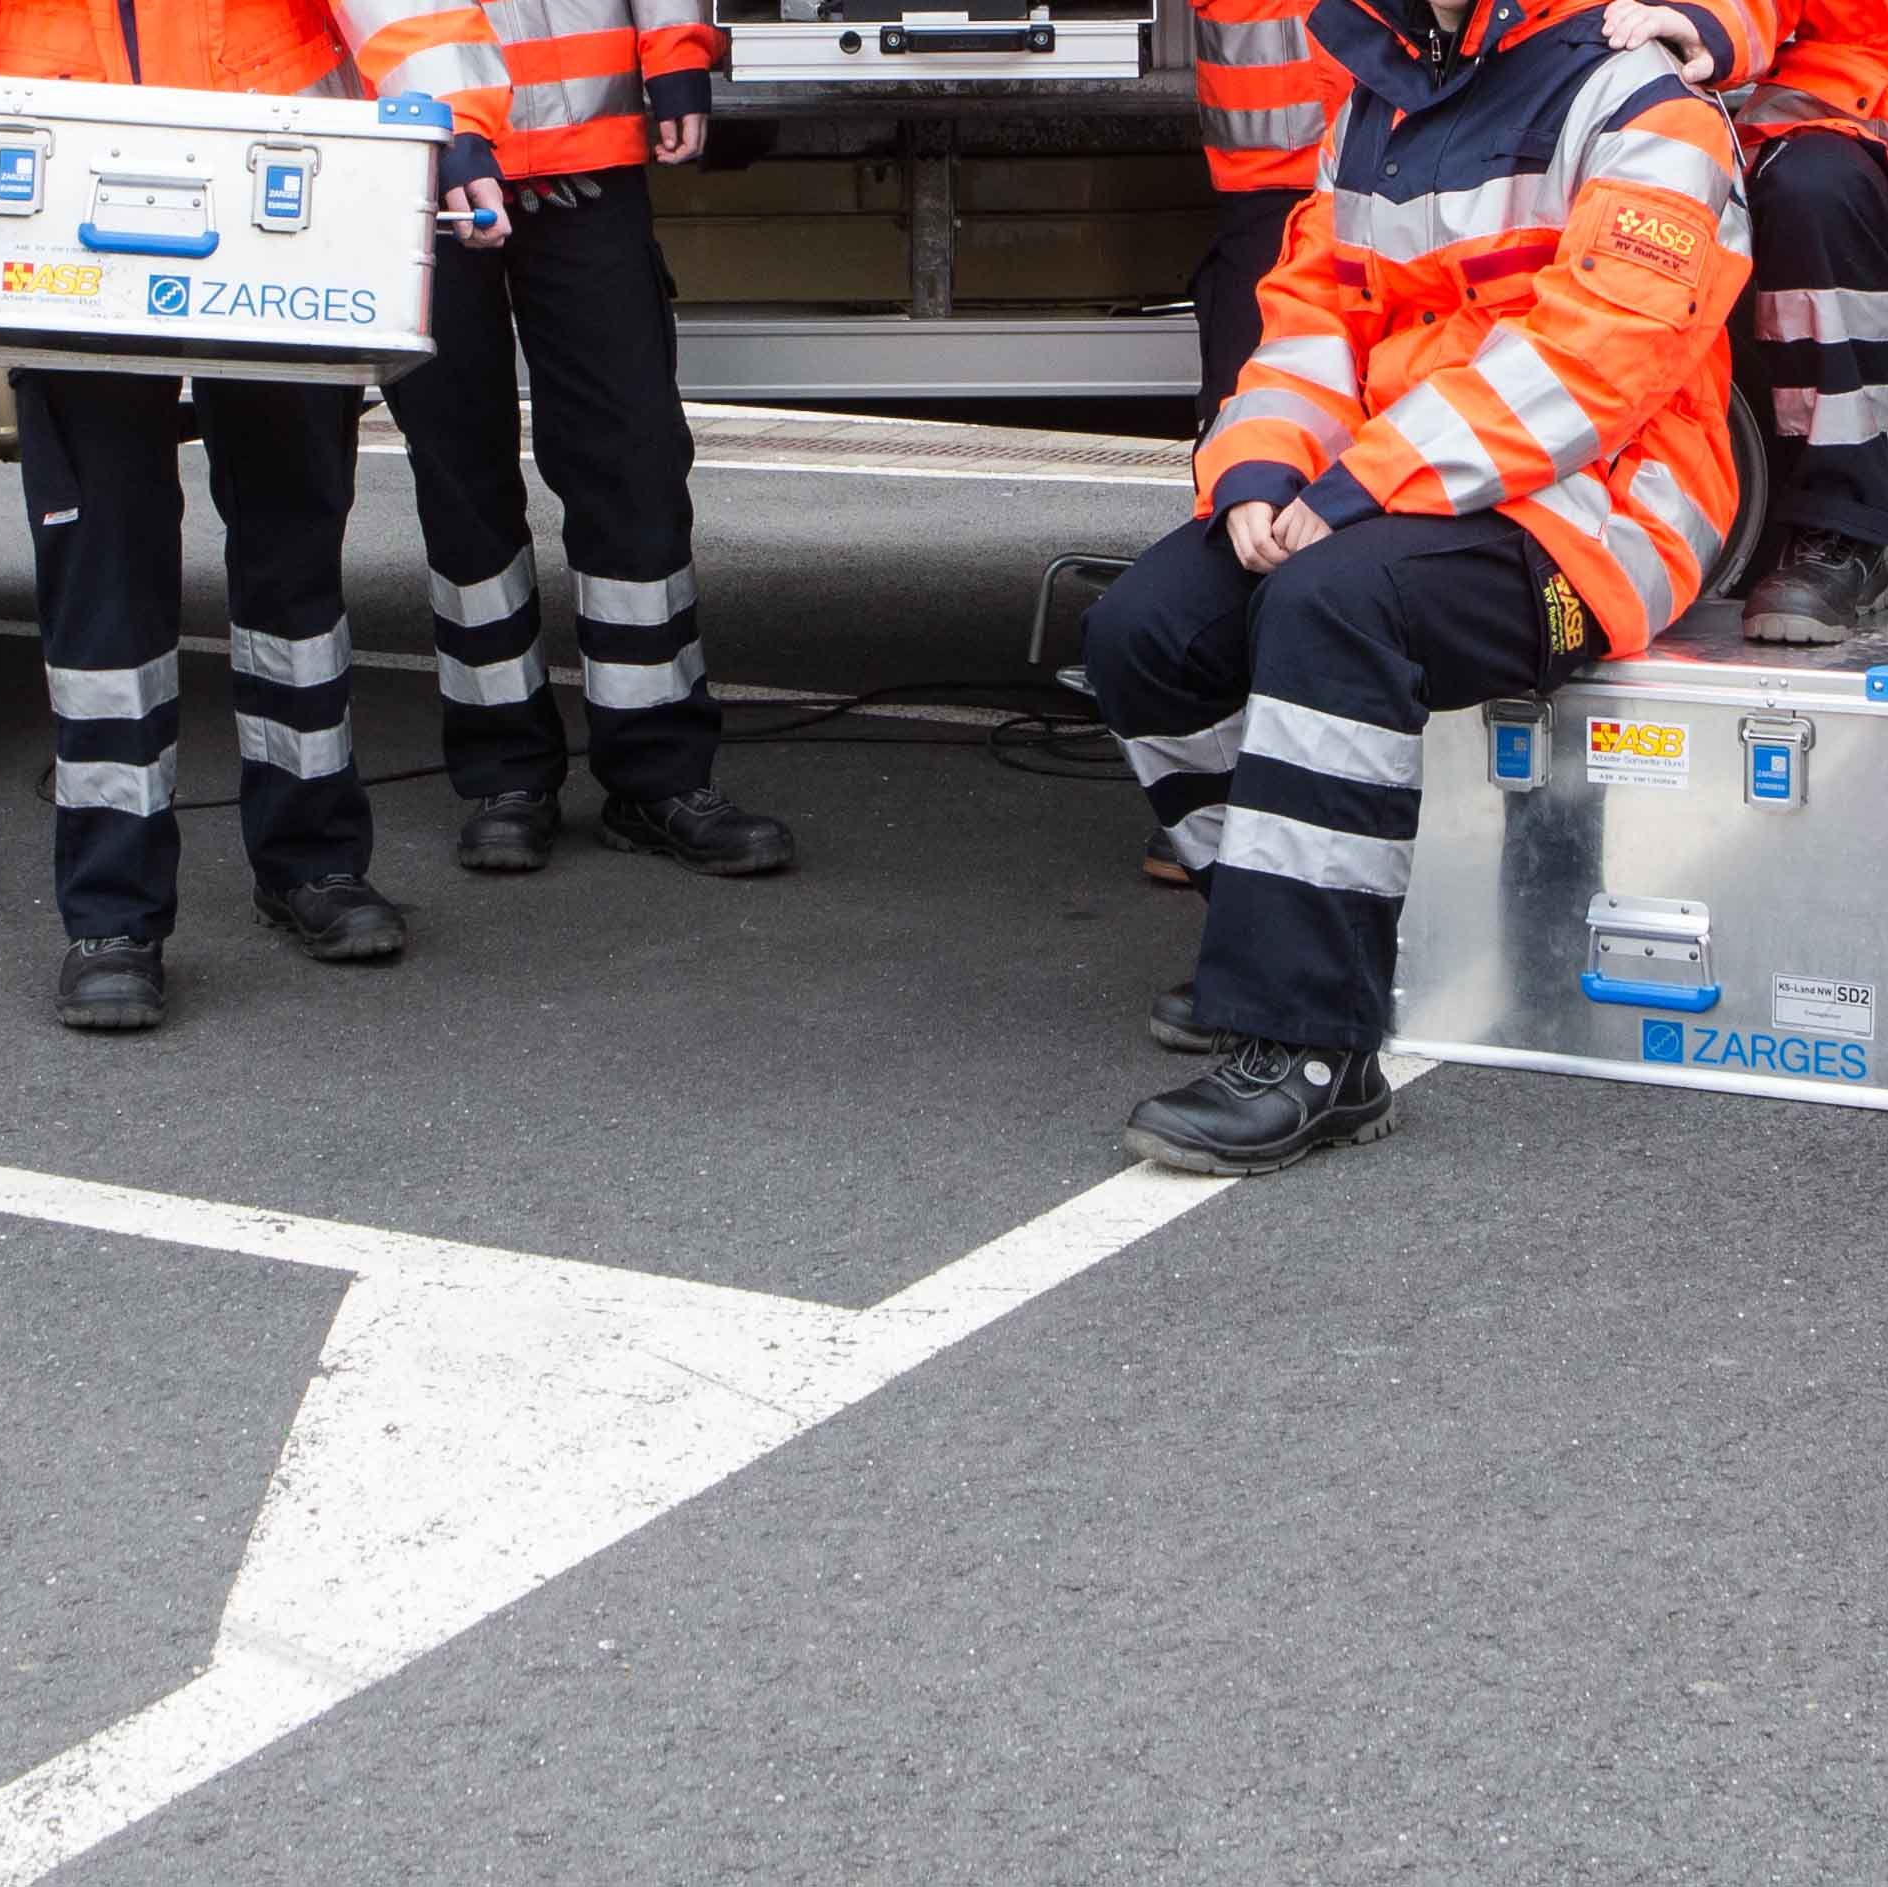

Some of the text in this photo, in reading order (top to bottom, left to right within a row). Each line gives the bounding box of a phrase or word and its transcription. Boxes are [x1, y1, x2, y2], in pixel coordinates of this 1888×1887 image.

[1615, 239, 1631, 252] RV
[1634, 245, 1660, 262] Ruhr
[1632, 217, 1696, 256] ASB
[23, 263, 103, 296] ASB
[199, 281, 377, 325] ZARGES
[1559, 594, 1584, 651] ASB
[1610, 723, 1685, 758] ASB
[1778, 982, 1833, 997] KS-Land NW
[1836, 986, 1871, 1005] SD2
[1692, 1027, 1868, 1080] ZARGES
